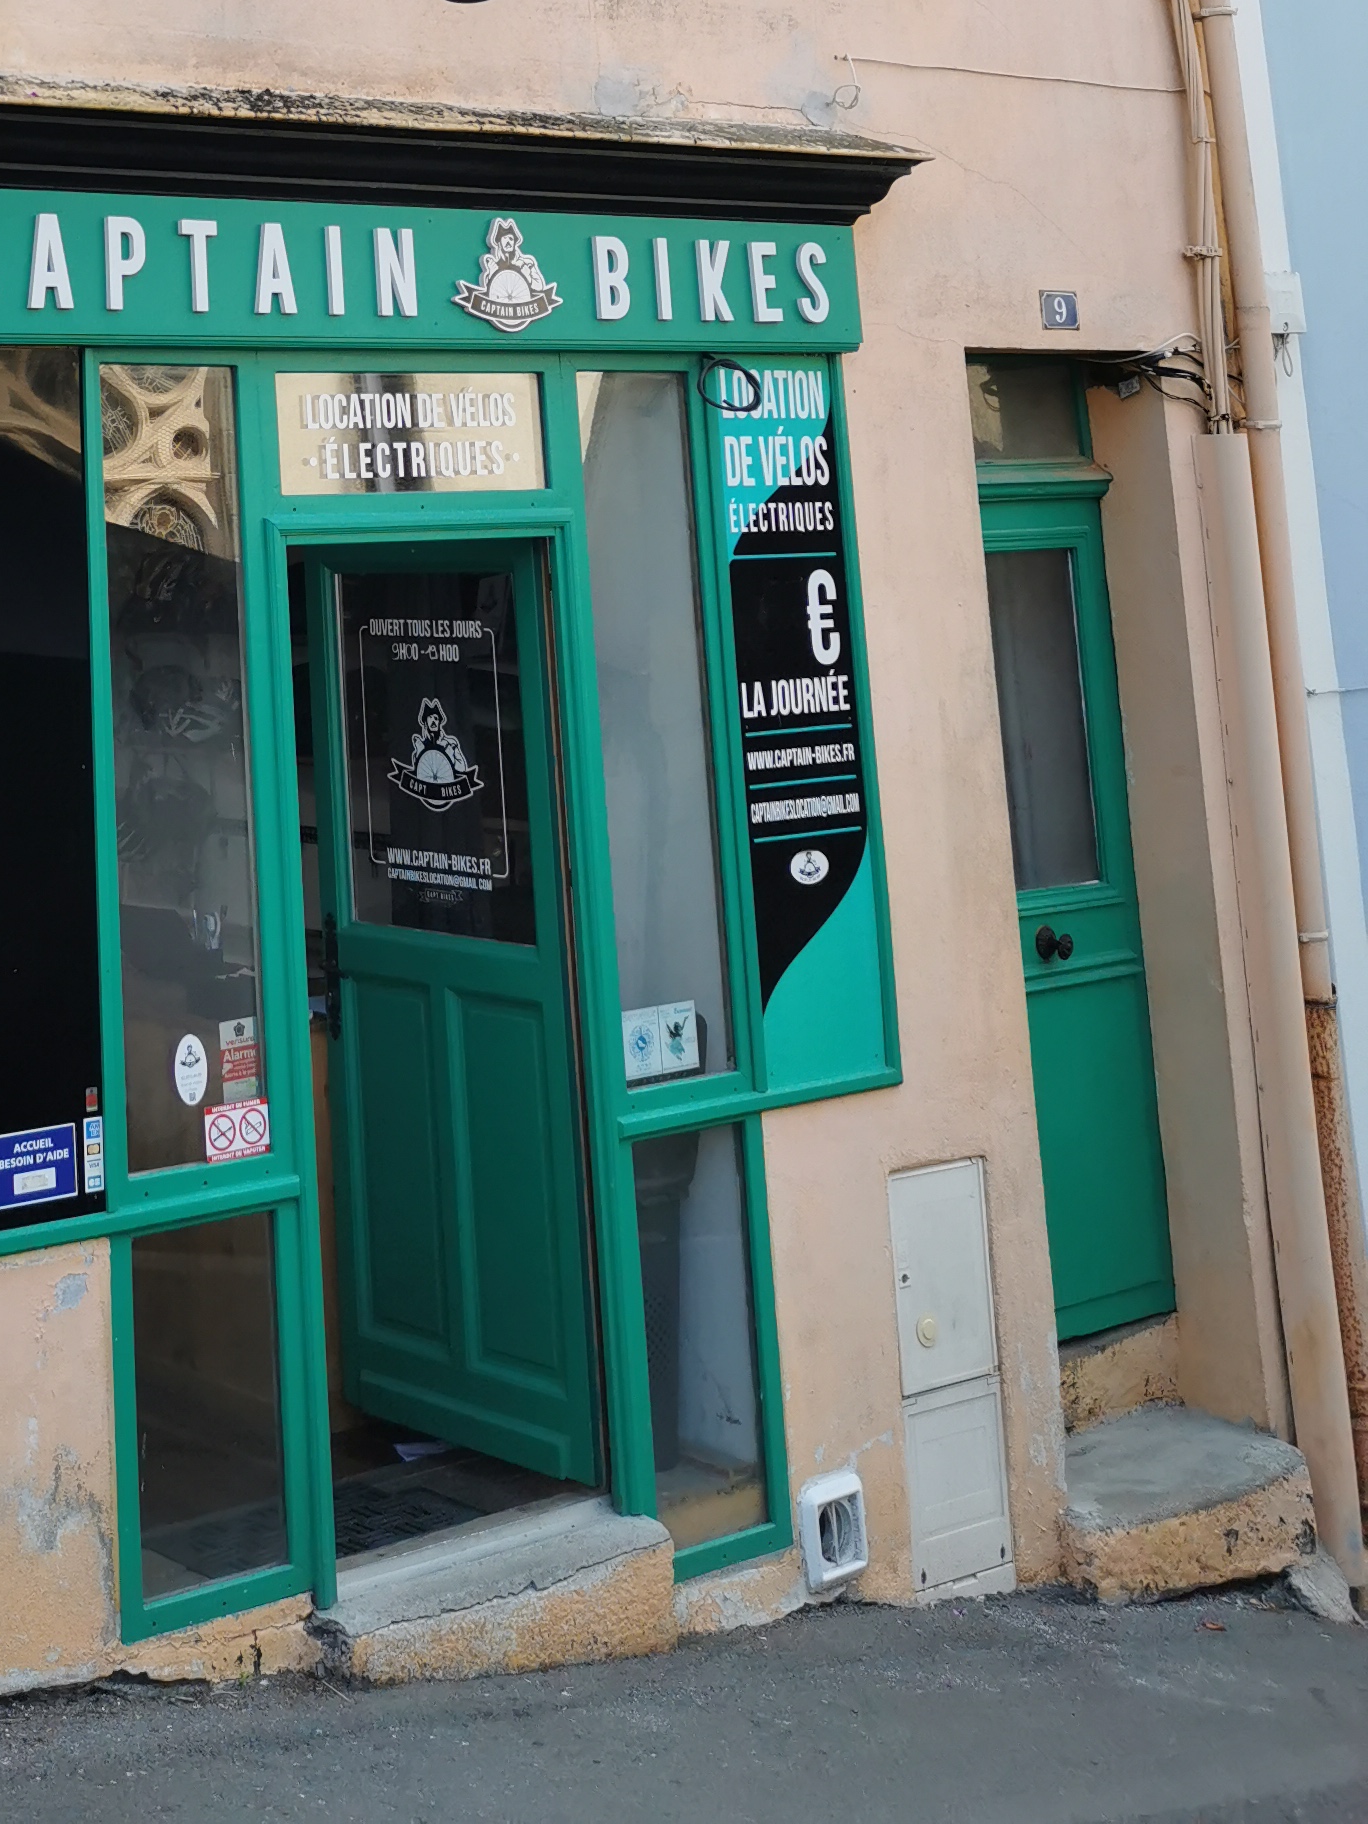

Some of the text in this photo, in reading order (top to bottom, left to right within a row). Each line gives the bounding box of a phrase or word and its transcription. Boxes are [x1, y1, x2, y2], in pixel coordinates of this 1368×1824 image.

[590, 234, 831, 324] BIKES
[480, 300, 539, 317] CAPTAIN BIKES
[1054, 296, 1067, 323] 9
[305, 386, 516, 430] LOCATION DE VÉLOS
[719, 368, 825, 420] LOCATION
[325, 436, 505, 480] ÉLECTRIQUES
[724, 426, 830, 487] DE VÉLOS
[730, 497, 834, 534] ÉLECTRIQUES
[369, 618, 483, 639] OUVERT TOUS LES JOURS
[806, 568, 841, 666] €
[741, 669, 851, 718] LA JOURNÉE
[747, 743, 855, 772] WWW.CAPTAIN-BIKES.FR
[409, 778, 462, 798] CAPT BIKES
[750, 792, 860, 824] CAPTAINBIKESLOCATION@GMAIL.COM
[386, 847, 491, 876] WWW.CAPTAIN-BIKES.FR
[13, 1137, 54, 1154] ACCUEIL
[36, 1147, 69, 1164] D'AIDE
